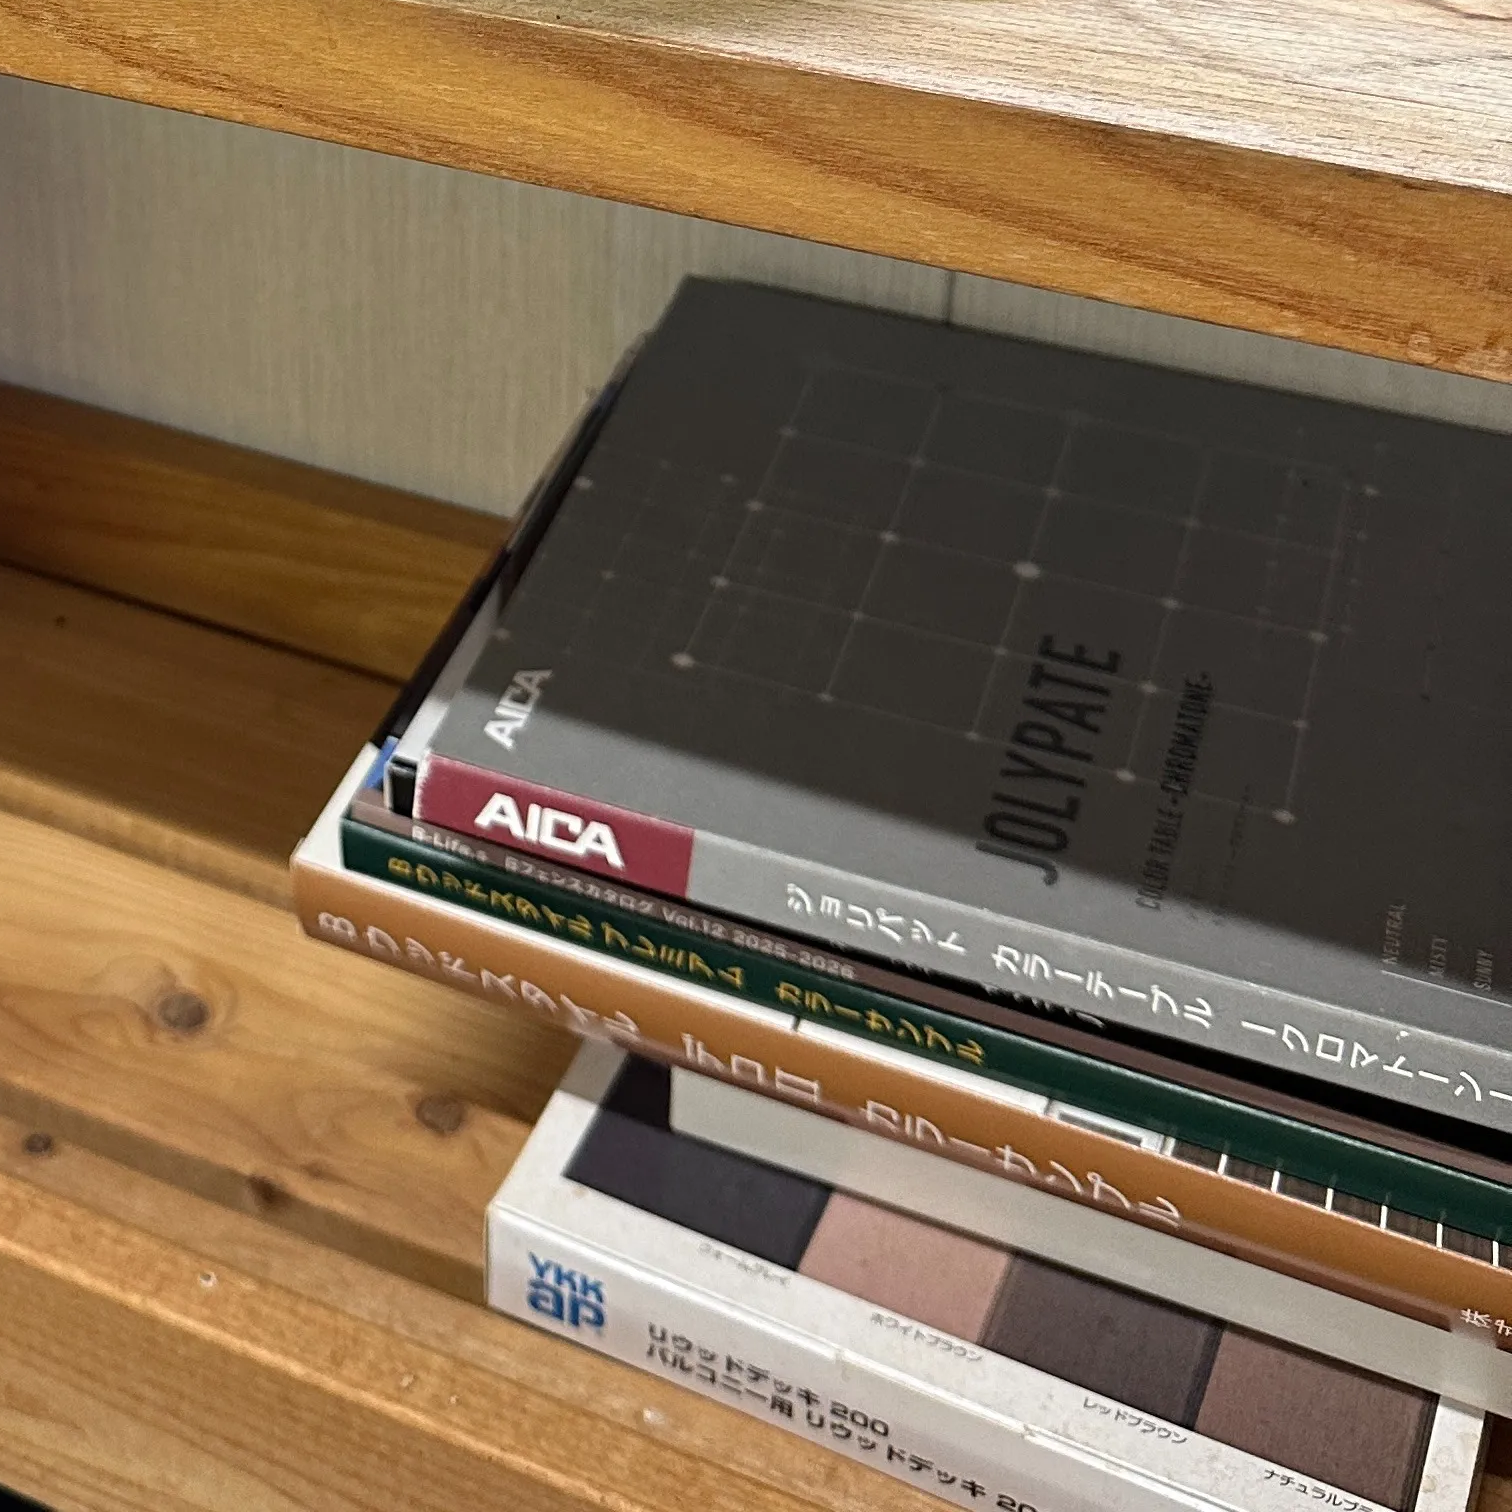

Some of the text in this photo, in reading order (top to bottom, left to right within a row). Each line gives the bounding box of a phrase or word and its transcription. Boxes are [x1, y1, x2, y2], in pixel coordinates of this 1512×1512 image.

[483, 668, 553, 752] AICA
[974, 633, 1122, 887] JOLYPATE
[473, 791, 625, 871] AICA
[1135, 857, 1171, 912] COLOR
[787, 882, 967, 957] ジョリパット
[991, 944, 1215, 1028] カラーテーブル
[775, 980, 986, 1066] カラーサンプル
[858, 1098, 1184, 1229] カラーサンプル
[526, 1250, 606, 1304] YKK
[870, 1310, 985, 1363] ホワイトブラウン
[645, 1340, 796, 1420] バルコニー用
[806, 1407, 987, 1499] リウッドデッキ
[646, 1321, 890, 1439] リウッドデッキ 200
[1082, 1395, 1189, 1445] レッドブラウン
